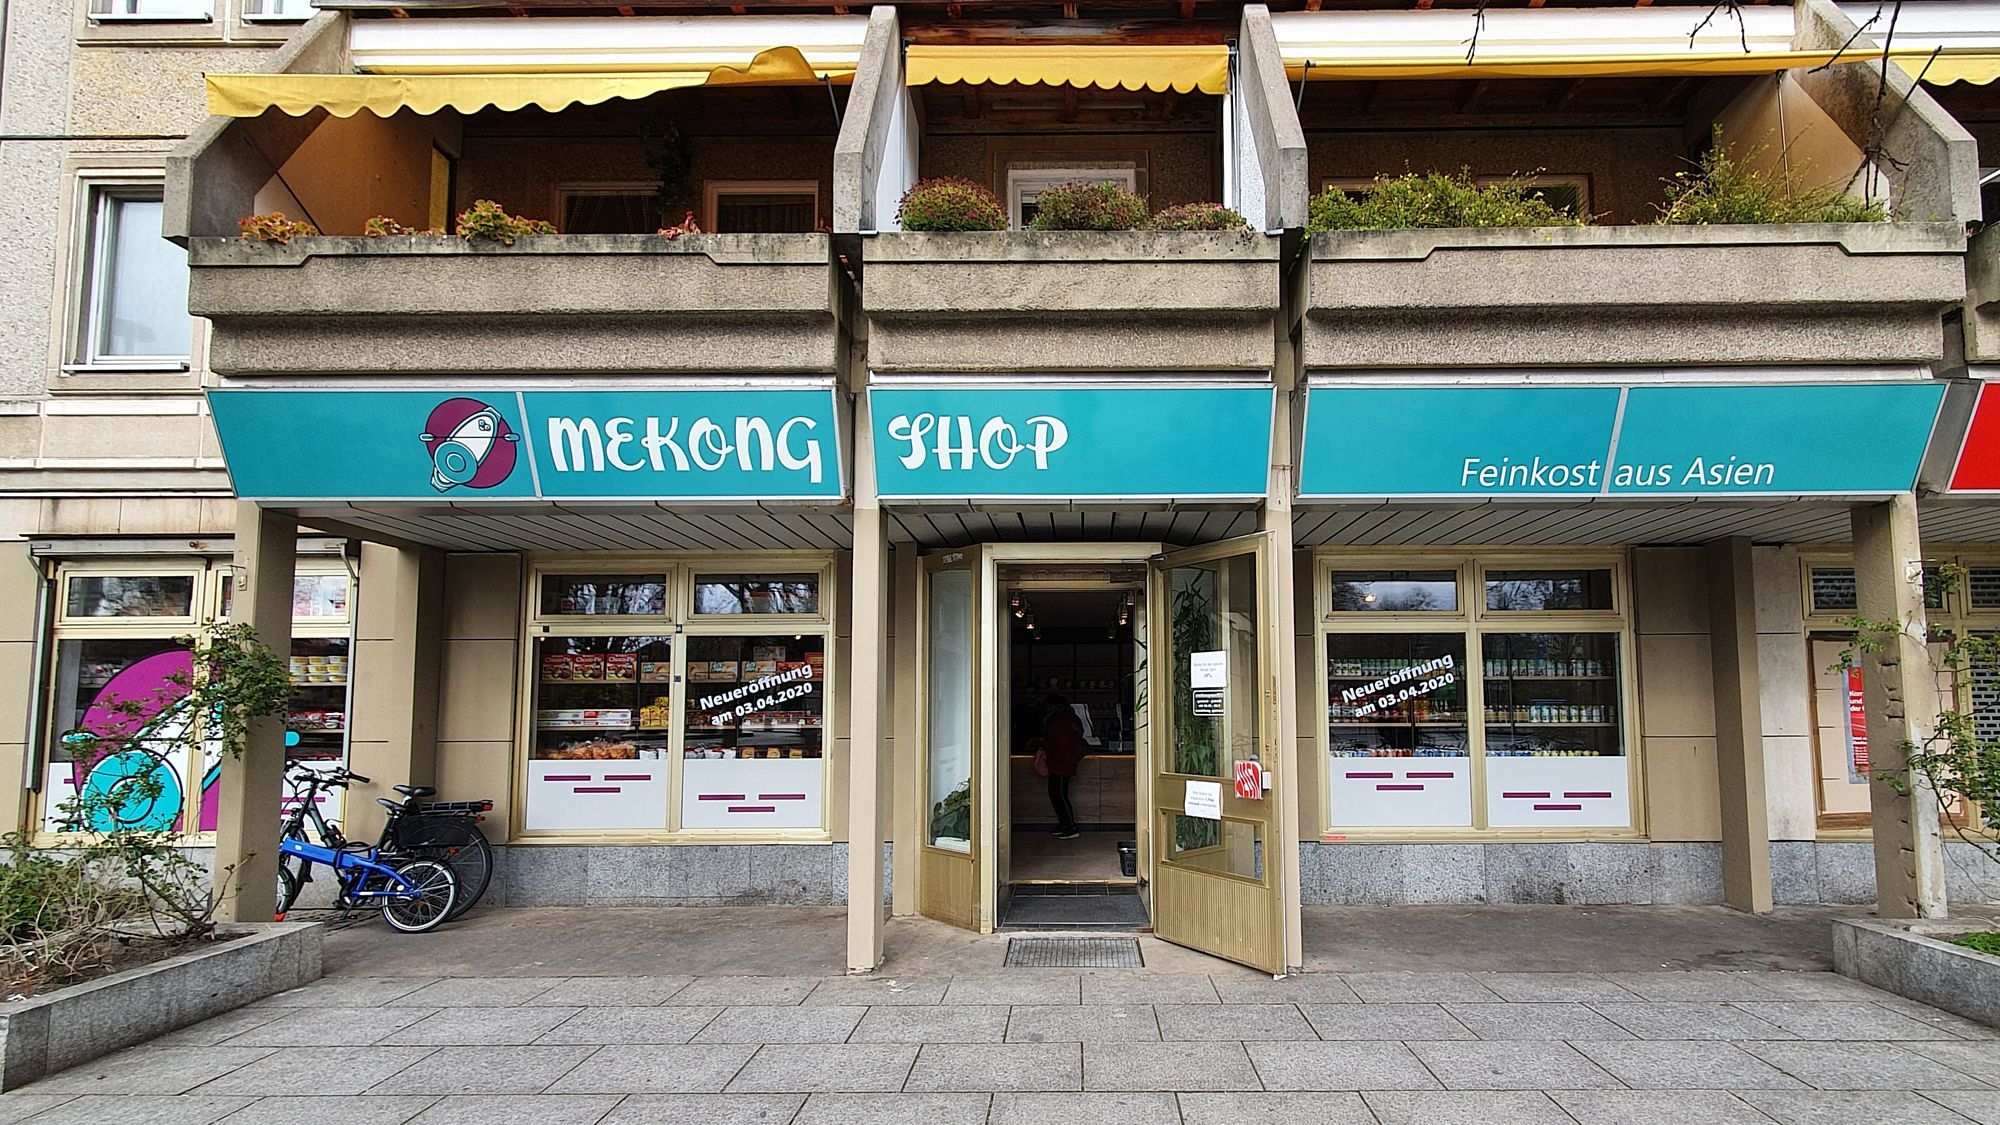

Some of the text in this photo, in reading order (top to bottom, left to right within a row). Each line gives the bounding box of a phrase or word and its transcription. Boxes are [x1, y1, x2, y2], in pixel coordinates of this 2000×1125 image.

[548, 413, 1069, 484] MEKONG SHOP
[1461, 455, 1775, 487] Feinkost aus Asien
[700, 664, 813, 710] Neueröffnung
[1341, 654, 1454, 703] Neueröffnung
[1354, 673, 1455, 718] am 03.04.2020
[711, 682, 813, 726] am 03.04.2020
